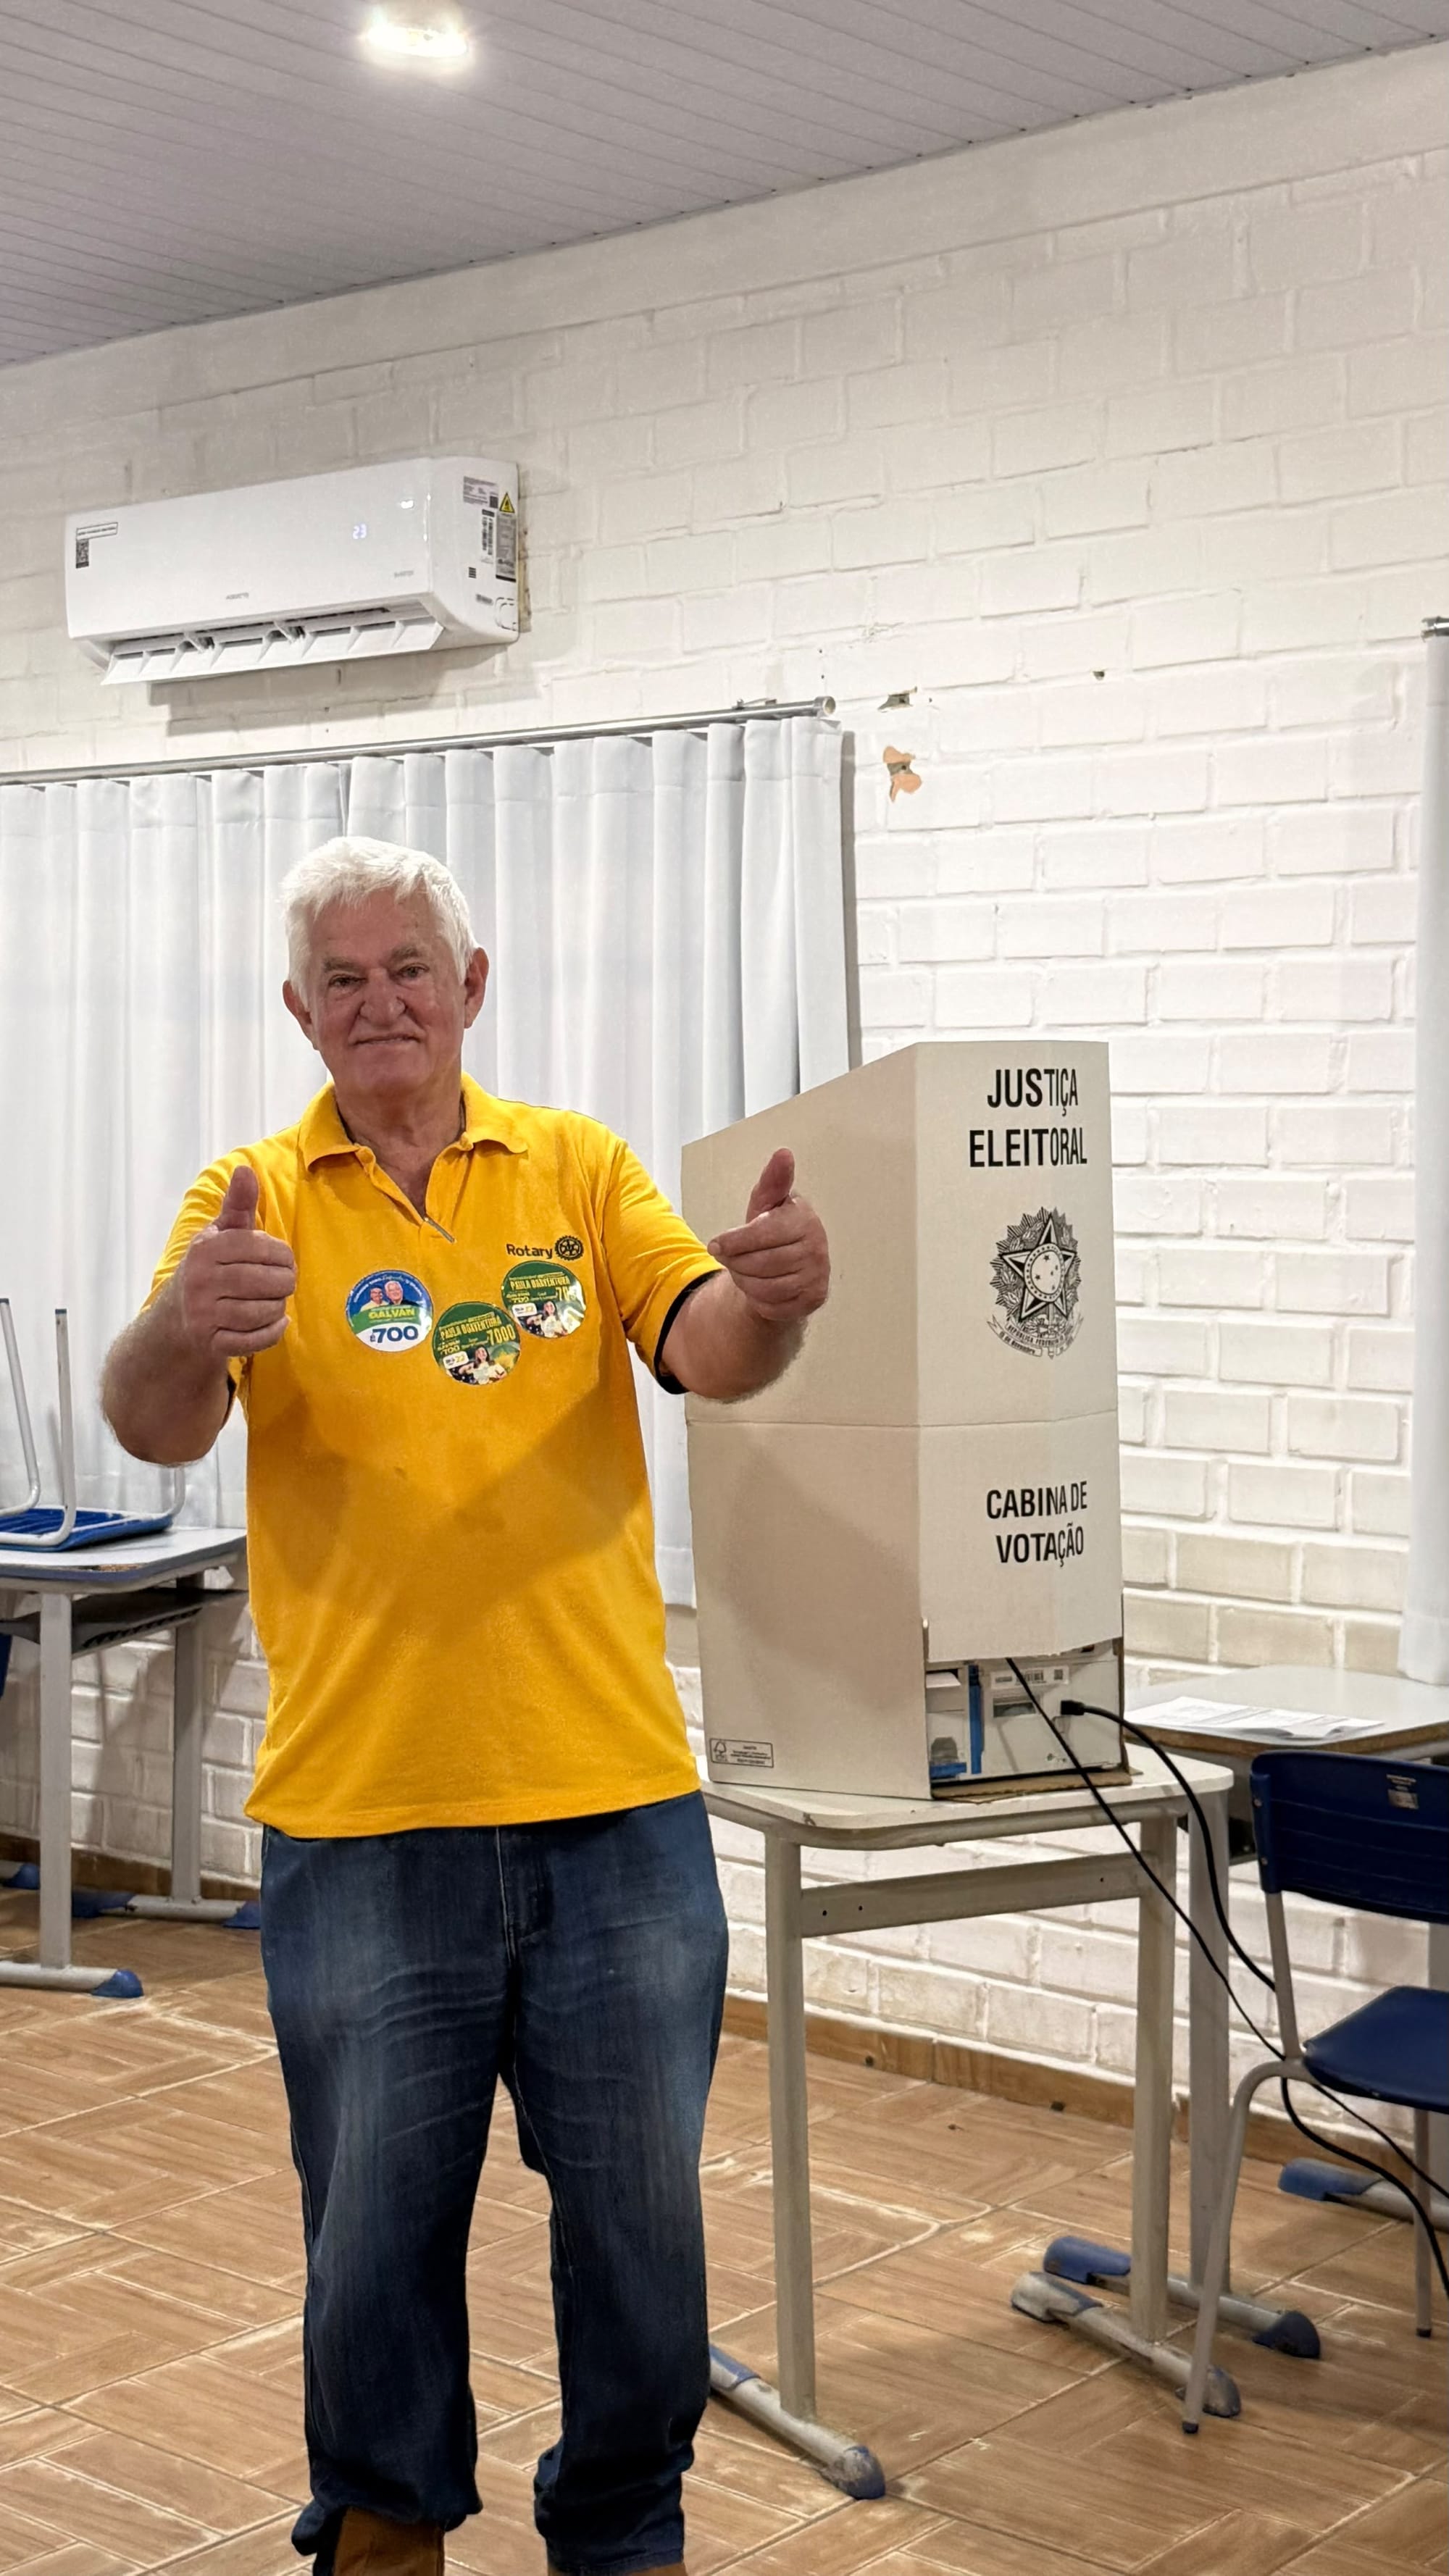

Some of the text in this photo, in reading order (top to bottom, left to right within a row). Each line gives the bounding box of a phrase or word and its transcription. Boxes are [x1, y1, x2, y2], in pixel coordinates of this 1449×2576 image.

[987, 1068, 1079, 1117] JUSTIÇA
[969, 1127, 1087, 1167] ELEITORAL
[506, 1243, 553, 1259] Rotary
[368, 1308, 415, 1319] GALVAN
[372, 1326, 419, 1344] 700
[486, 1323, 516, 1346] 7000
[986, 1480, 1087, 1520] CABINA DE
[995, 1521, 1085, 1568] VOTAÇÃO
